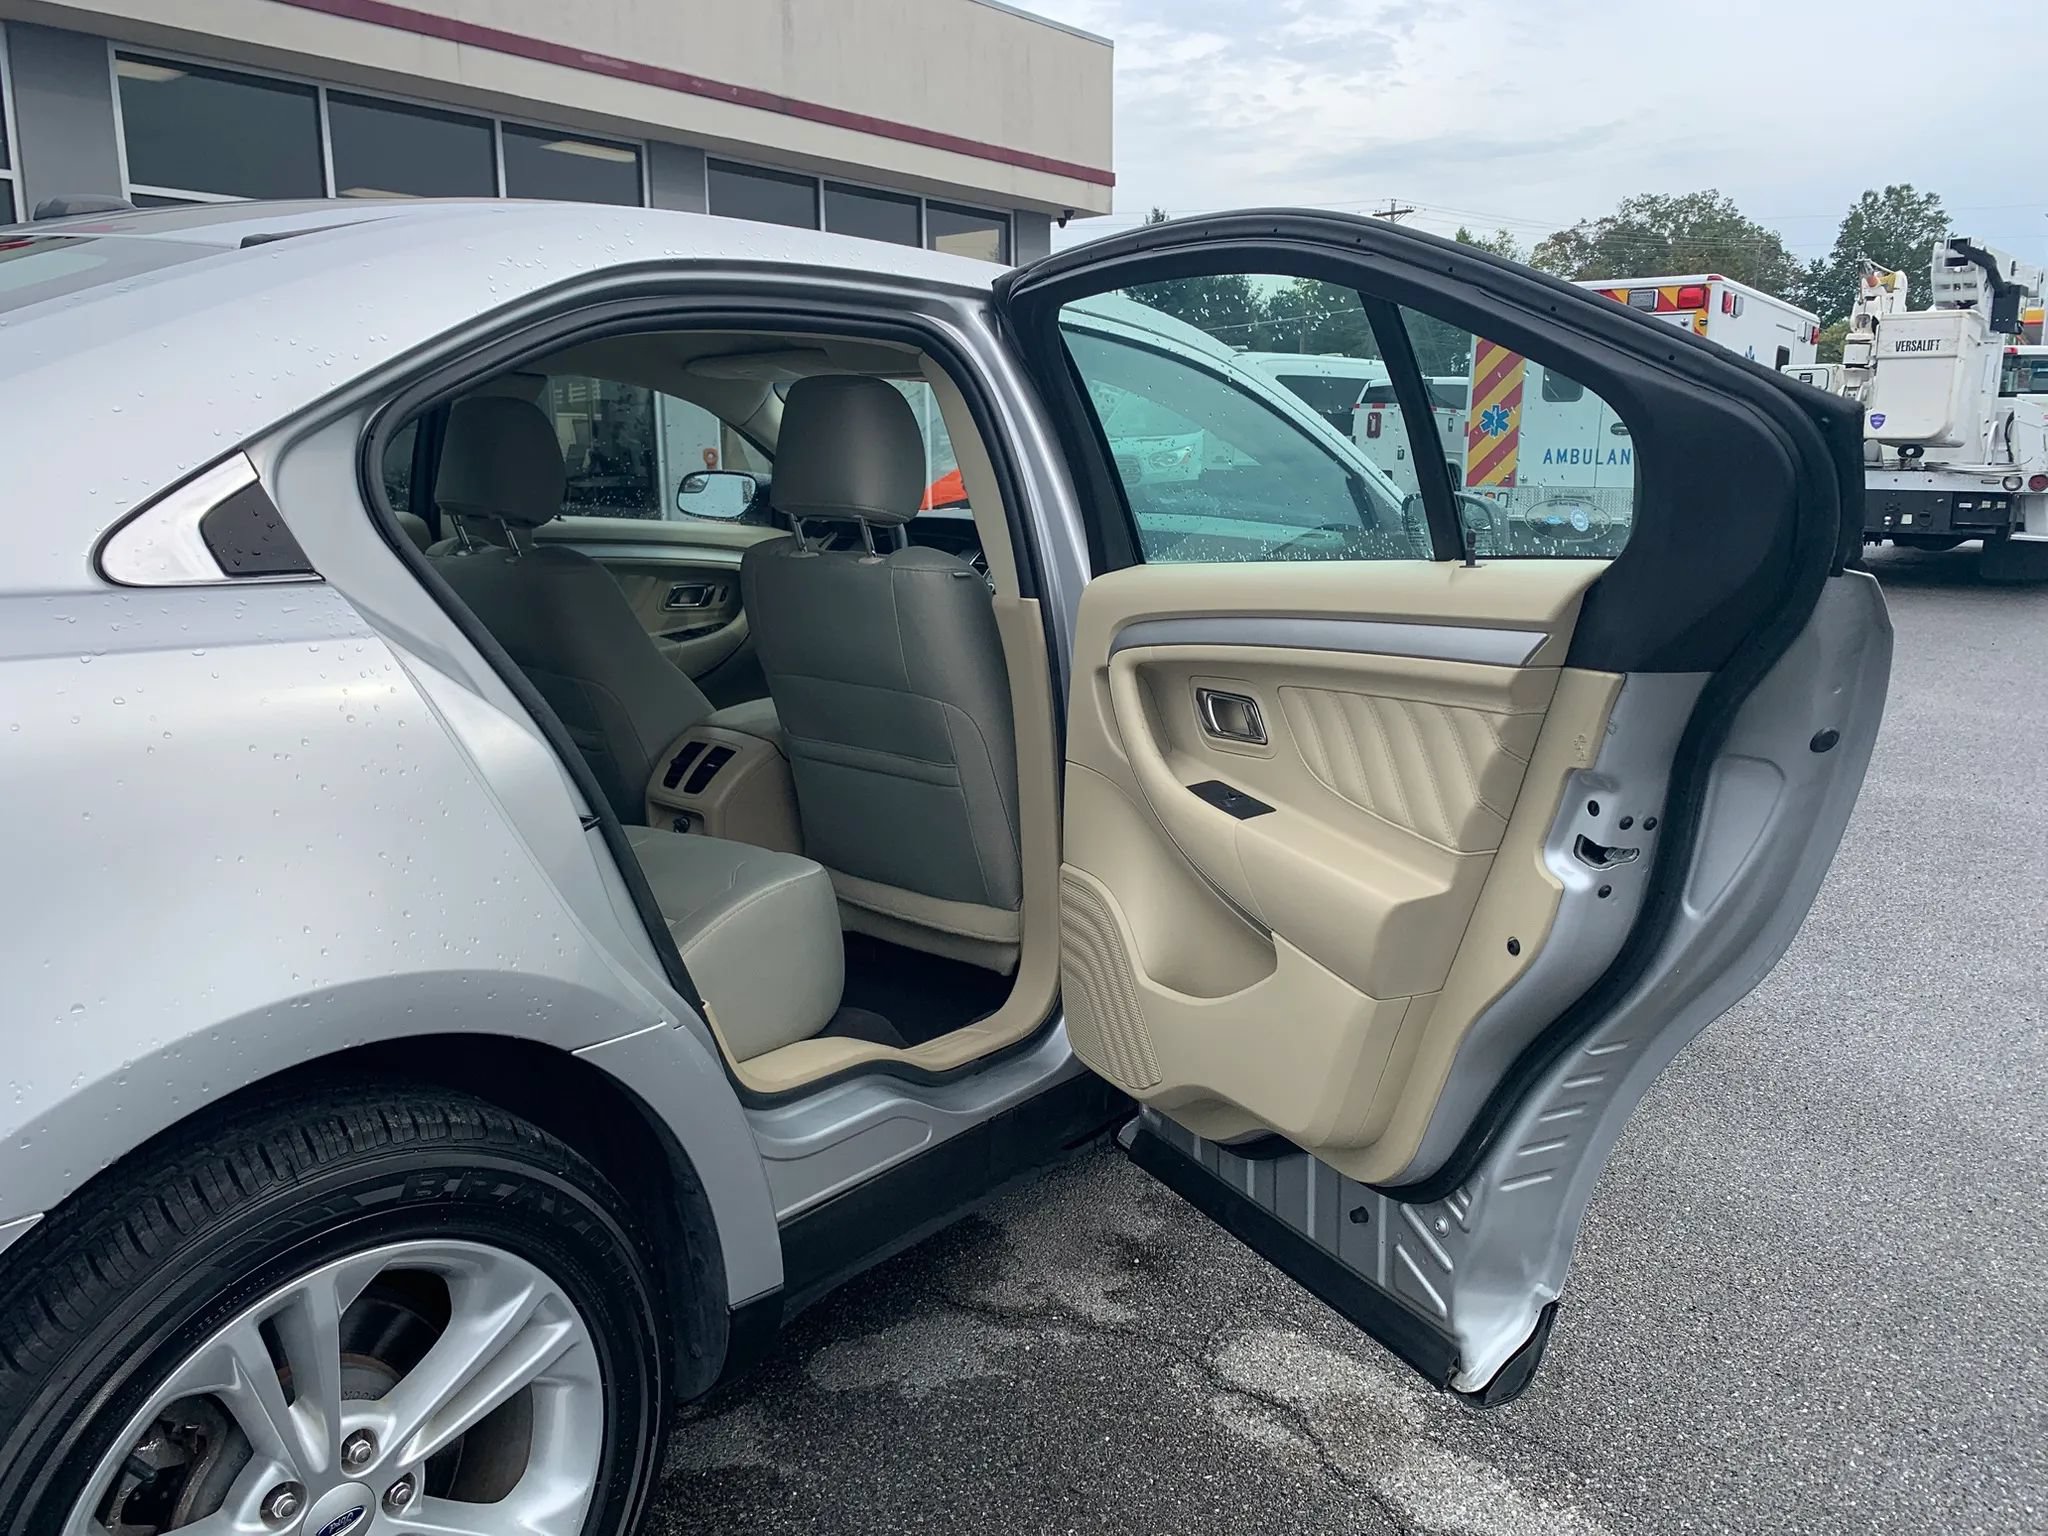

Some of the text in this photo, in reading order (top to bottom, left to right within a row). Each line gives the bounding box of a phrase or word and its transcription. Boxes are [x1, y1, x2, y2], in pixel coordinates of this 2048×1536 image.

[1895, 339, 1941, 352] VERSALIFT
[1543, 448, 1631, 465] AMBULAN
[328, 1511, 354, 1534] Ford
